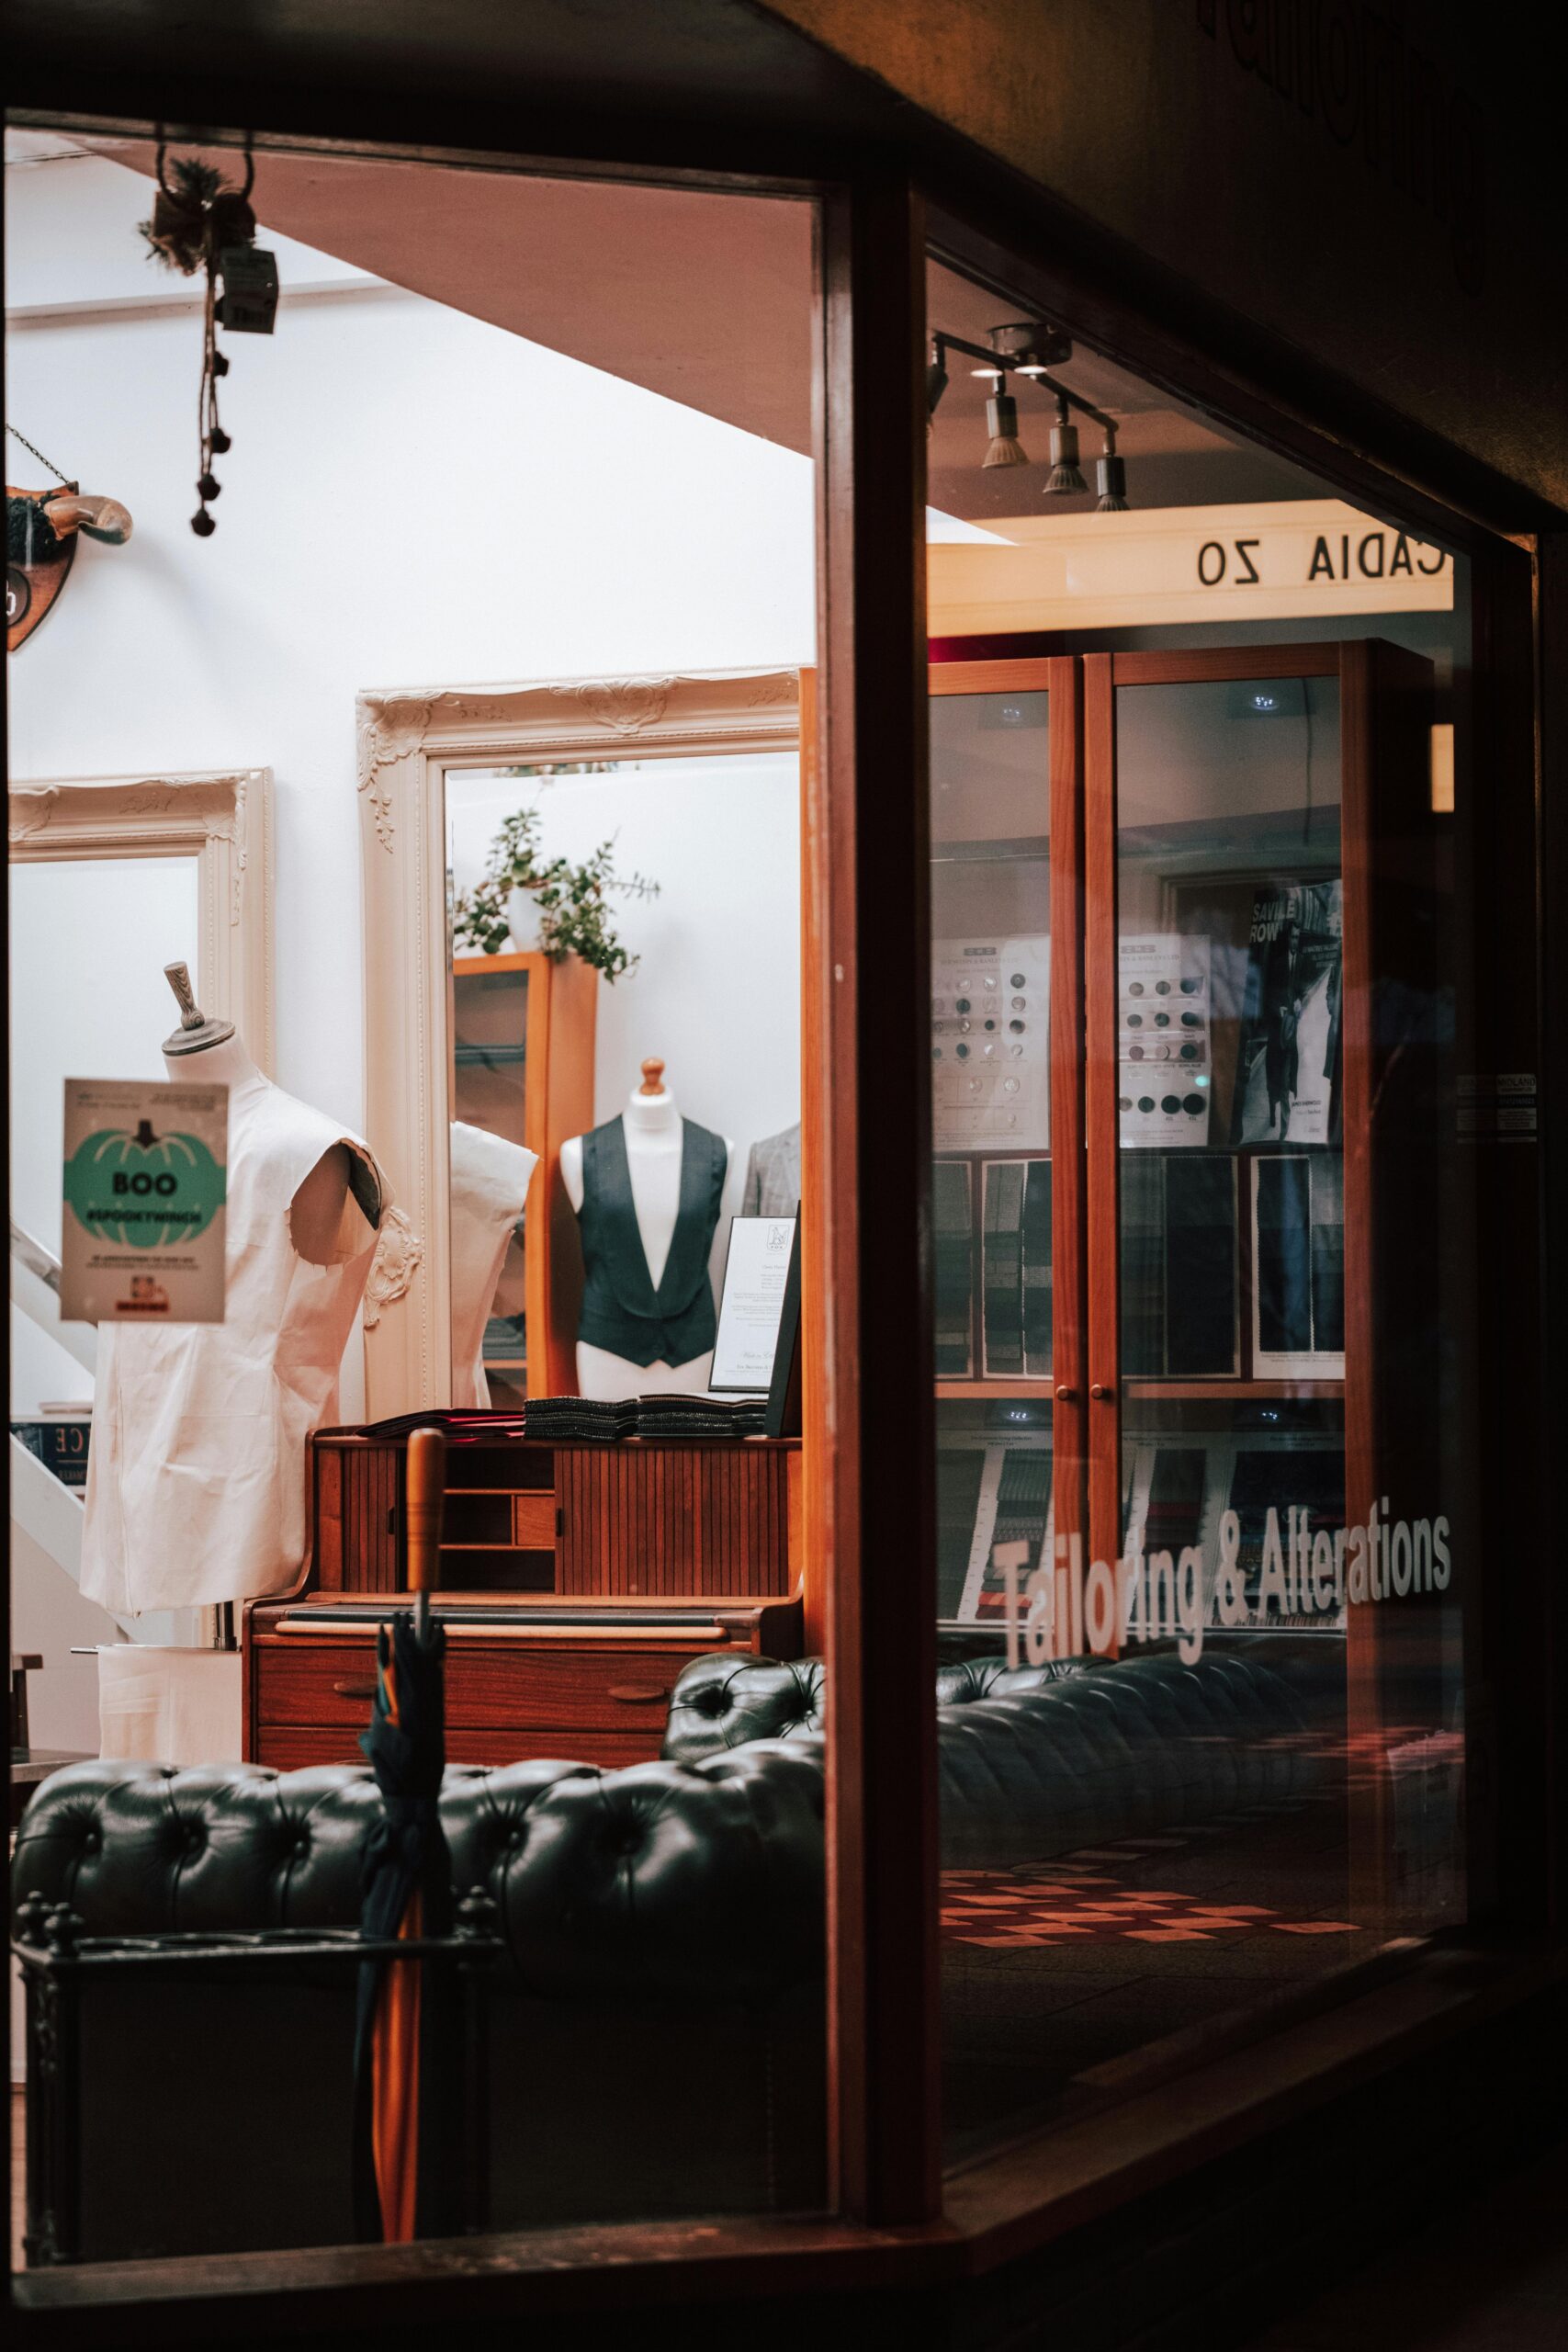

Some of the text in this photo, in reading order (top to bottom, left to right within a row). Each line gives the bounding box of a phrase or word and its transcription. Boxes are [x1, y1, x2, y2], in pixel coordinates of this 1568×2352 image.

[1197, 0, 1485, 298] ailoring
[1252, 899, 1295, 922] SAVILE
[1249, 922, 1279, 944] ROW
[112, 1172, 177, 1195] BOO
[993, 1496, 1451, 1671] Tailoring & Alterations
